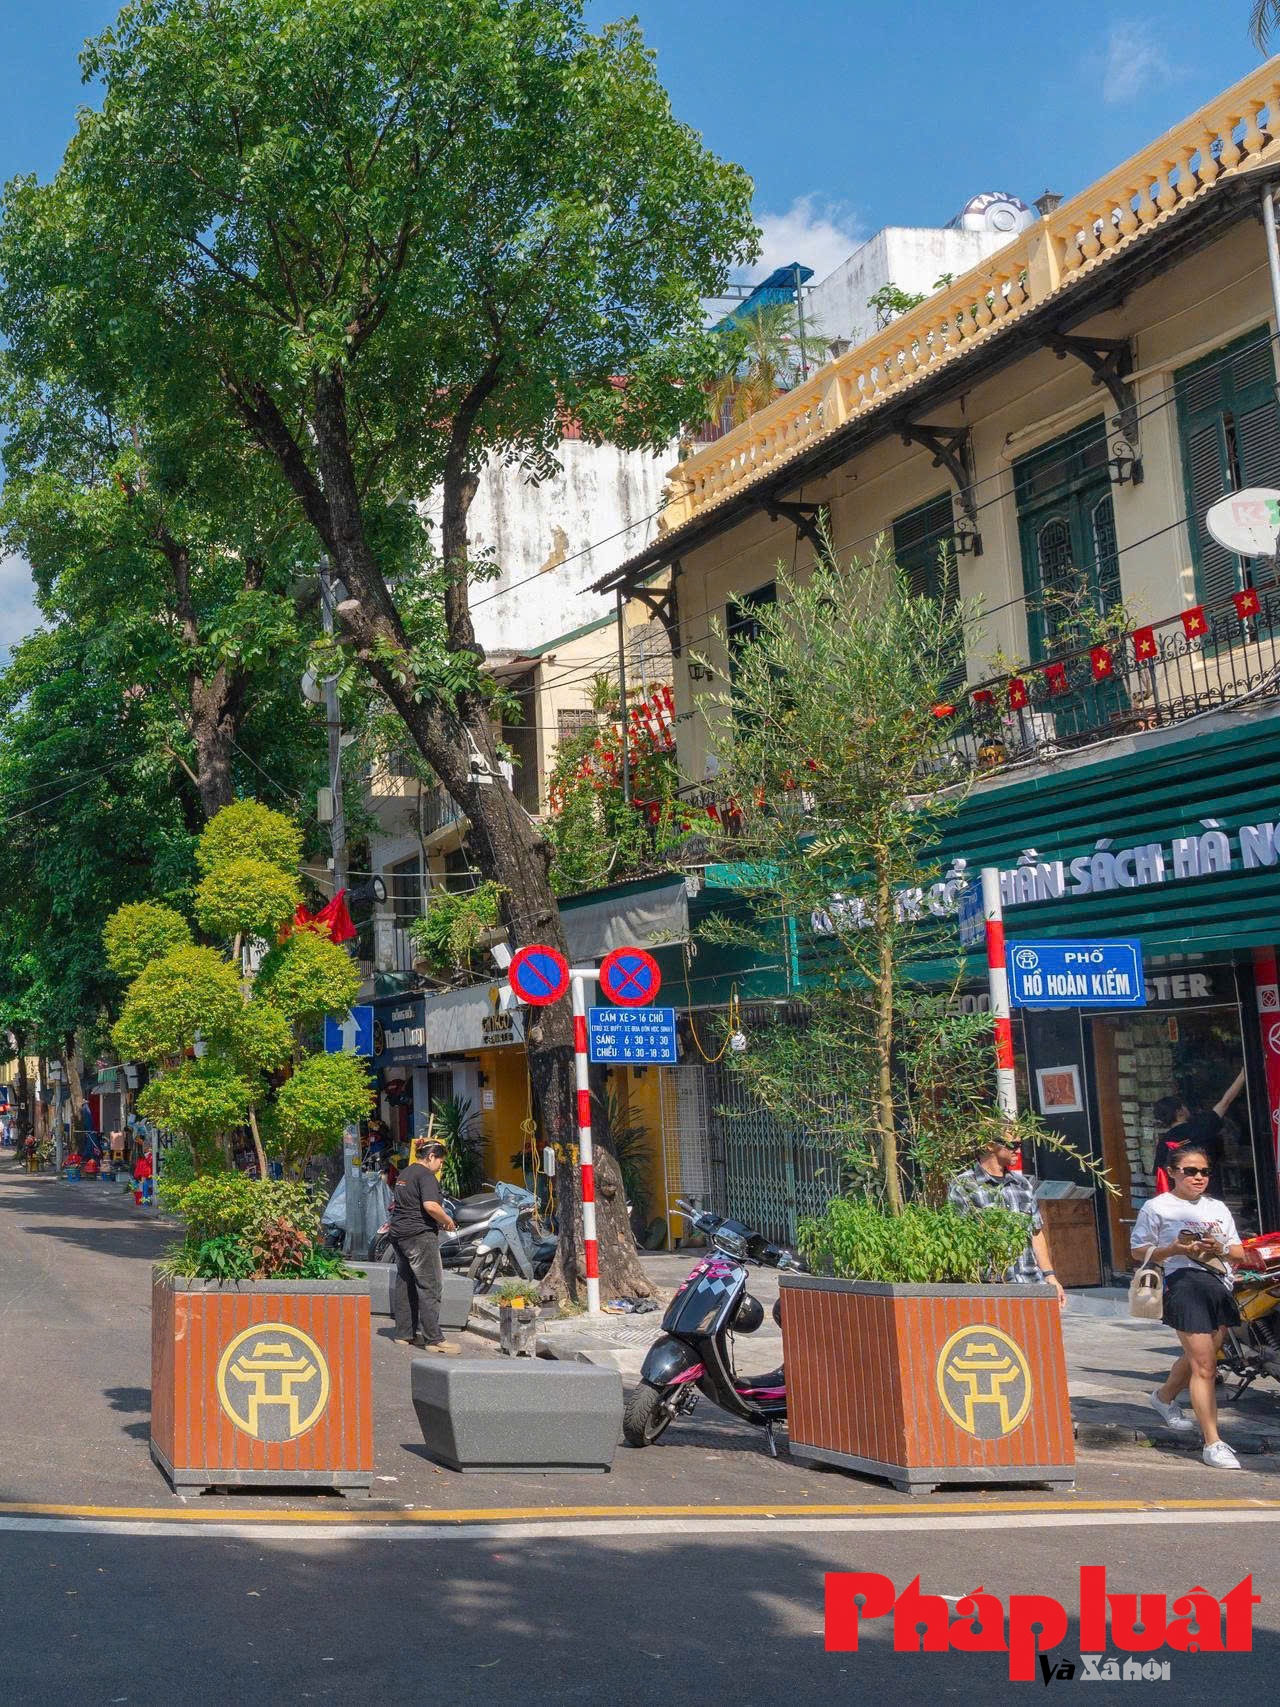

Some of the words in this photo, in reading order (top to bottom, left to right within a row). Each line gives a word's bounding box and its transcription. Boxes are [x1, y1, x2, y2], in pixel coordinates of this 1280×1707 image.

[999, 848, 1064, 906] HẦN
[1070, 838, 1164, 895] SÁCH
[1172, 818, 1231, 879] HÀ
[1239, 818, 1280, 869] N
[1064, 948, 1104, 964] PHỐ
[1022, 968, 1043, 996] HỒ
[1047, 970, 1088, 996] HOÀN
[1091, 967, 1131, 996] KIẾM
[599, 1010, 616, 1022] CẤM
[619, 1013, 629, 1022] XE
[638, 1013, 646, 1022] 16
[648, 1011, 664, 1022] CHỖ
